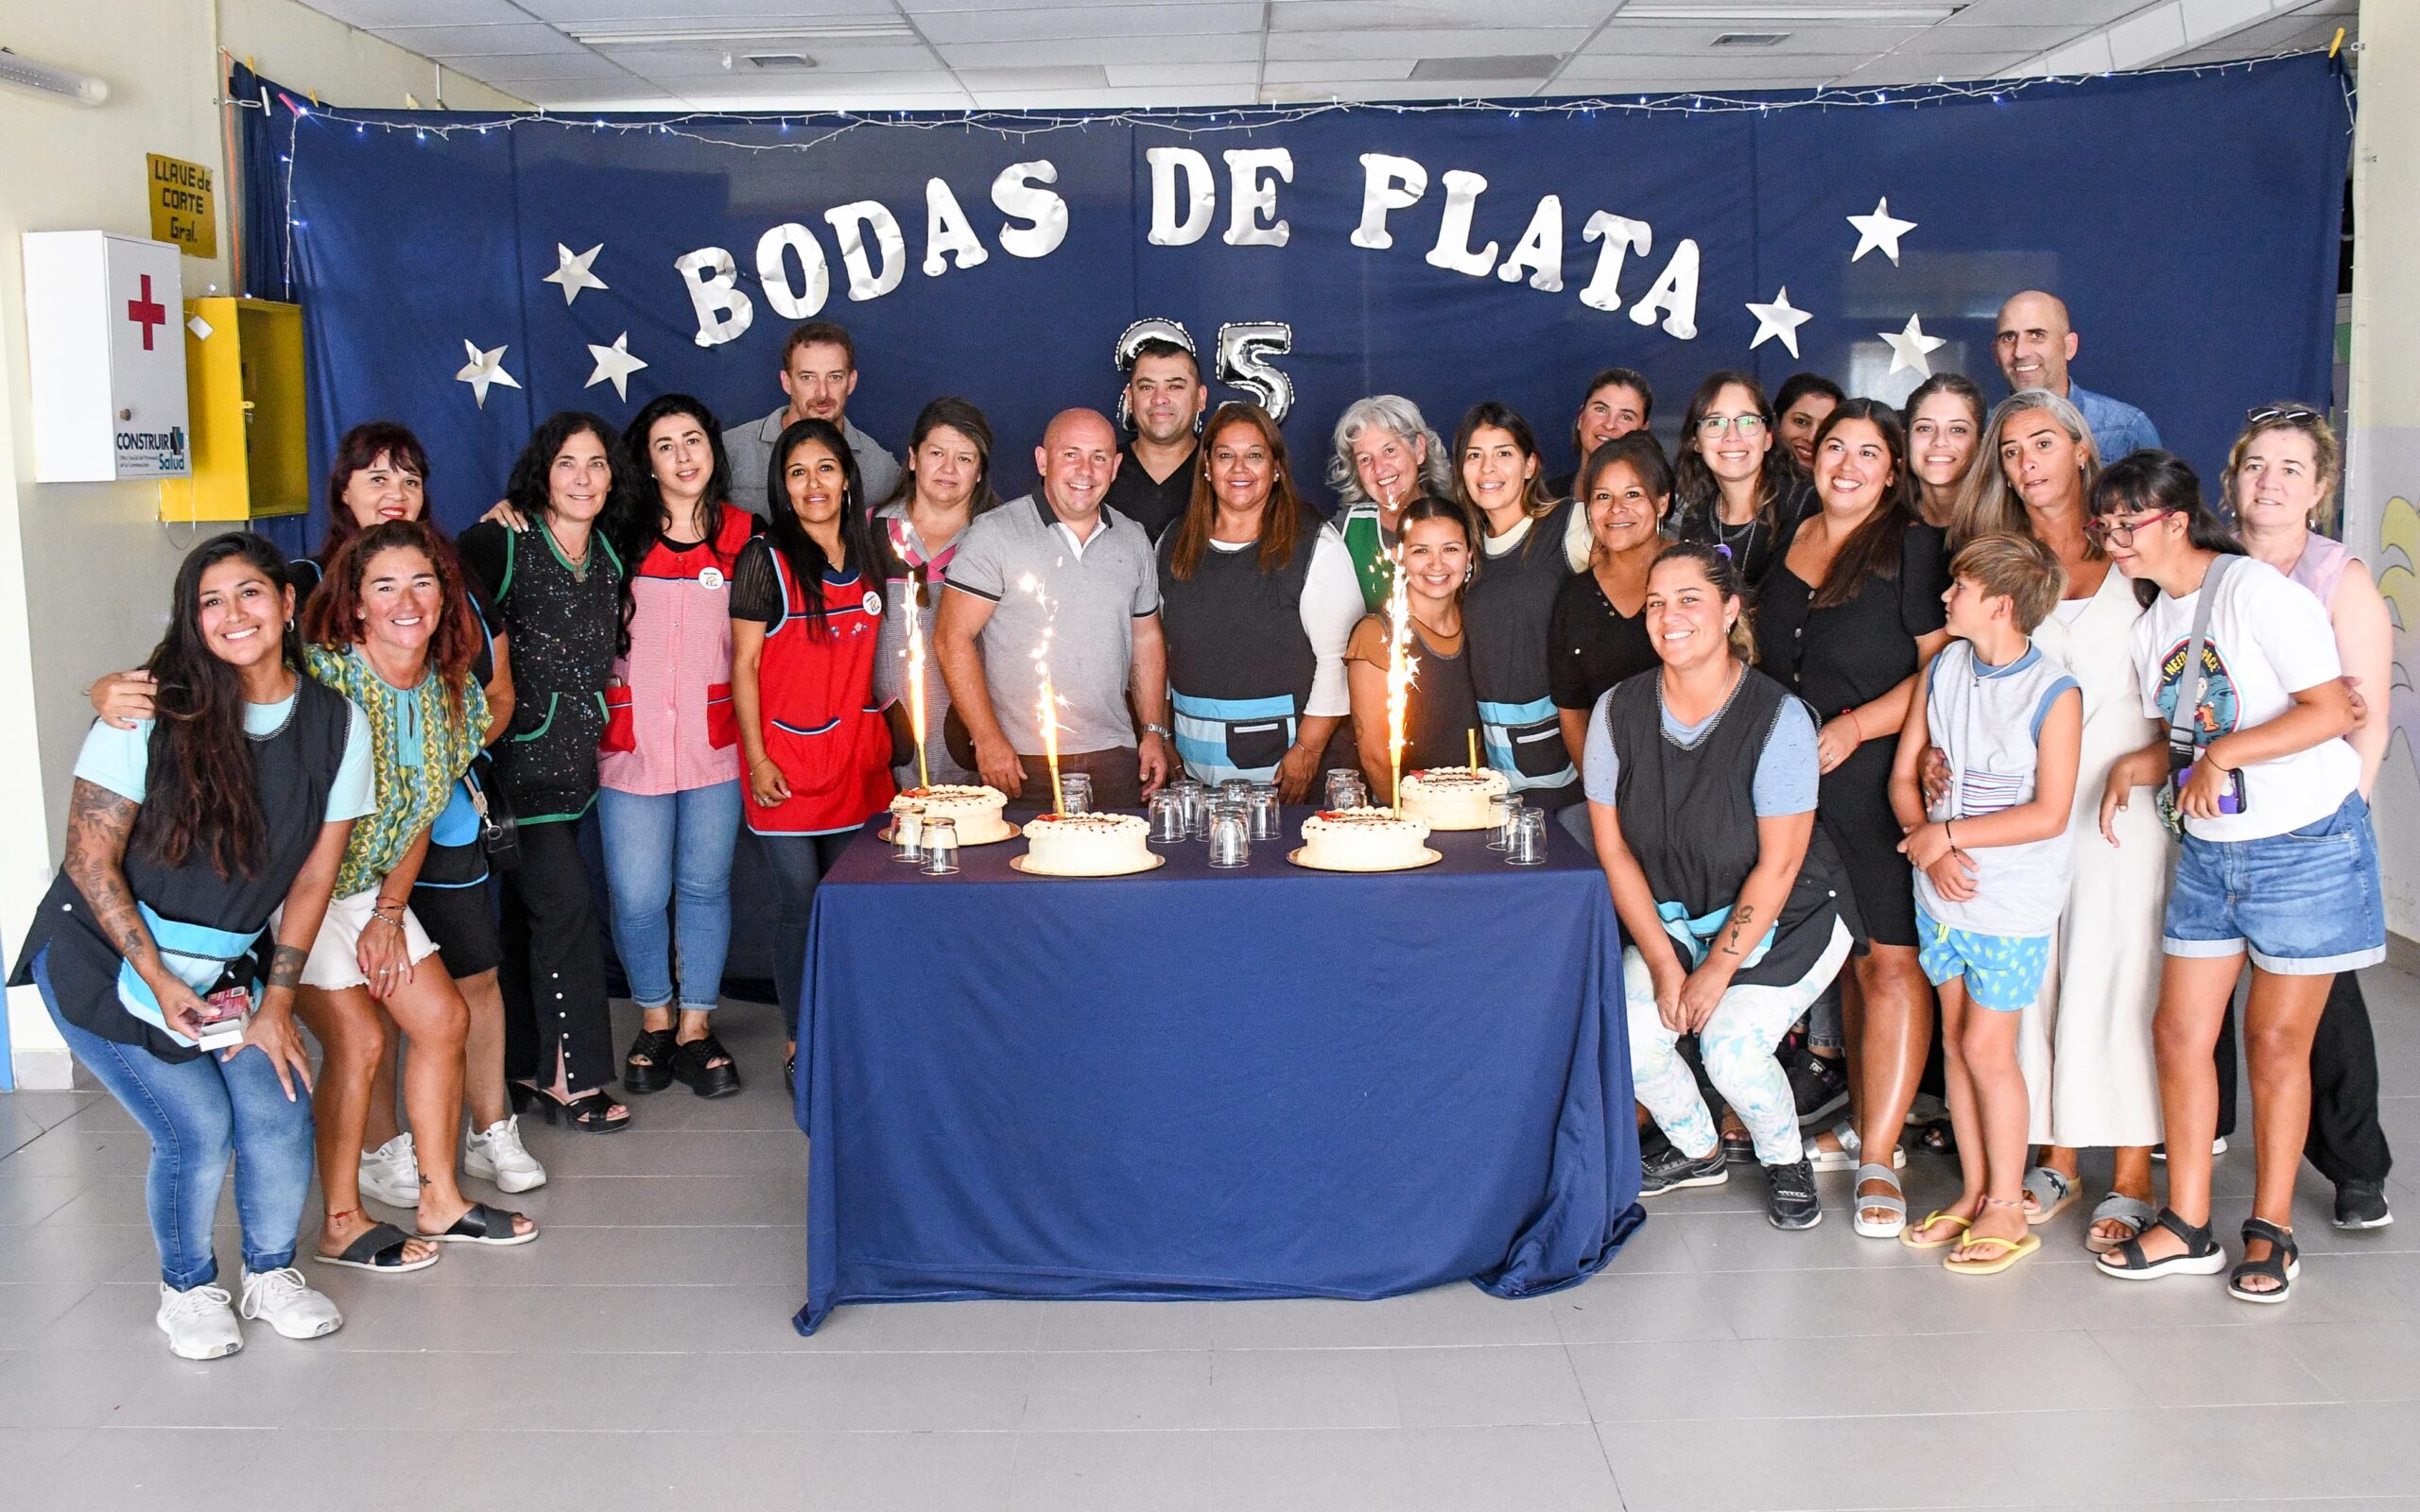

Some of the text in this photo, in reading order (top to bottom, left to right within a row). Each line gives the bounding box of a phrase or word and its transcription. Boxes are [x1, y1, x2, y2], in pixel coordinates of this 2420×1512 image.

[154, 159, 211, 193] LLAVE de
[163, 187, 203, 215] CORTE
[170, 216, 198, 243] Gral.
[674, 146, 1702, 348] BODAS DE PLATA
[116, 433, 169, 450] CONSTRUIR
[159, 452, 184, 470] Salud
[2165, 651, 2187, 676] NEED
[2201, 648, 2219, 673] PACE
